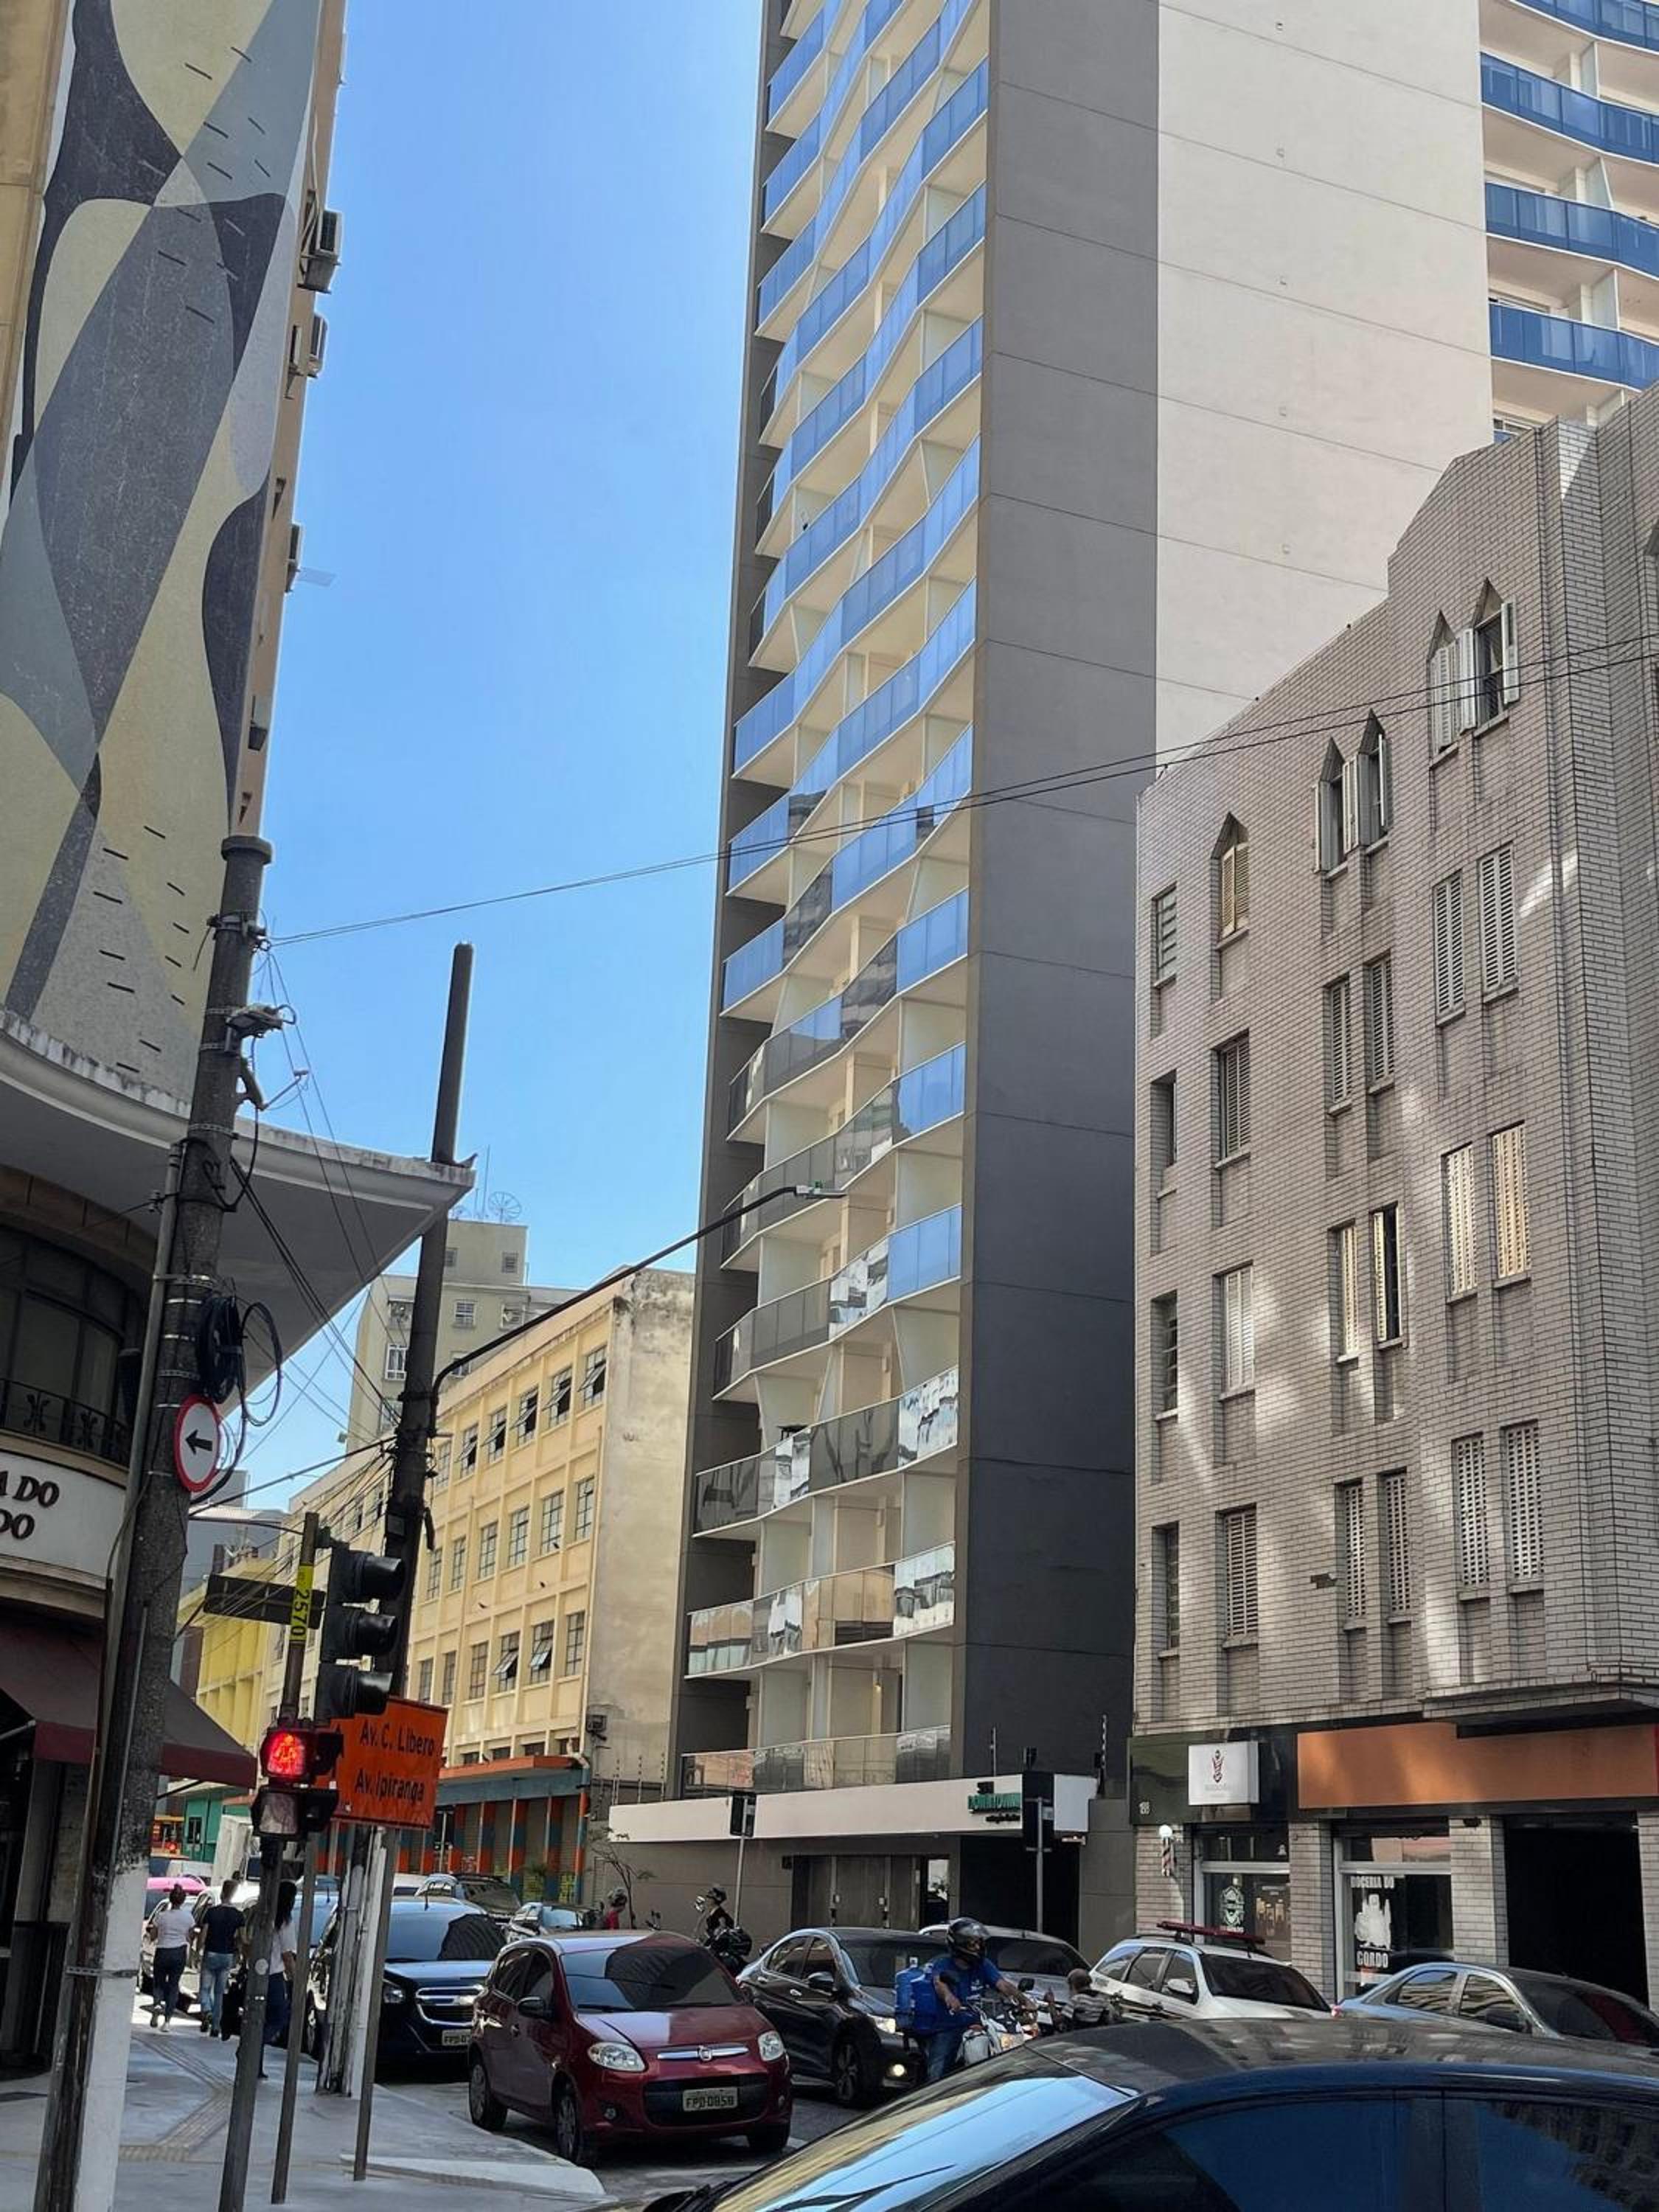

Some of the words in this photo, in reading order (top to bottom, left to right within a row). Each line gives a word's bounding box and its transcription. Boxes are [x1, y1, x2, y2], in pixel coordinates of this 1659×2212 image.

[291, 1589, 309, 1636] 2570
[360, 1719, 378, 1746] Av.
[381, 1722, 392, 1750] C.
[397, 1725, 434, 1756] Libero
[355, 1767, 372, 1794] Av.
[376, 1770, 425, 1804] Ipiranga
